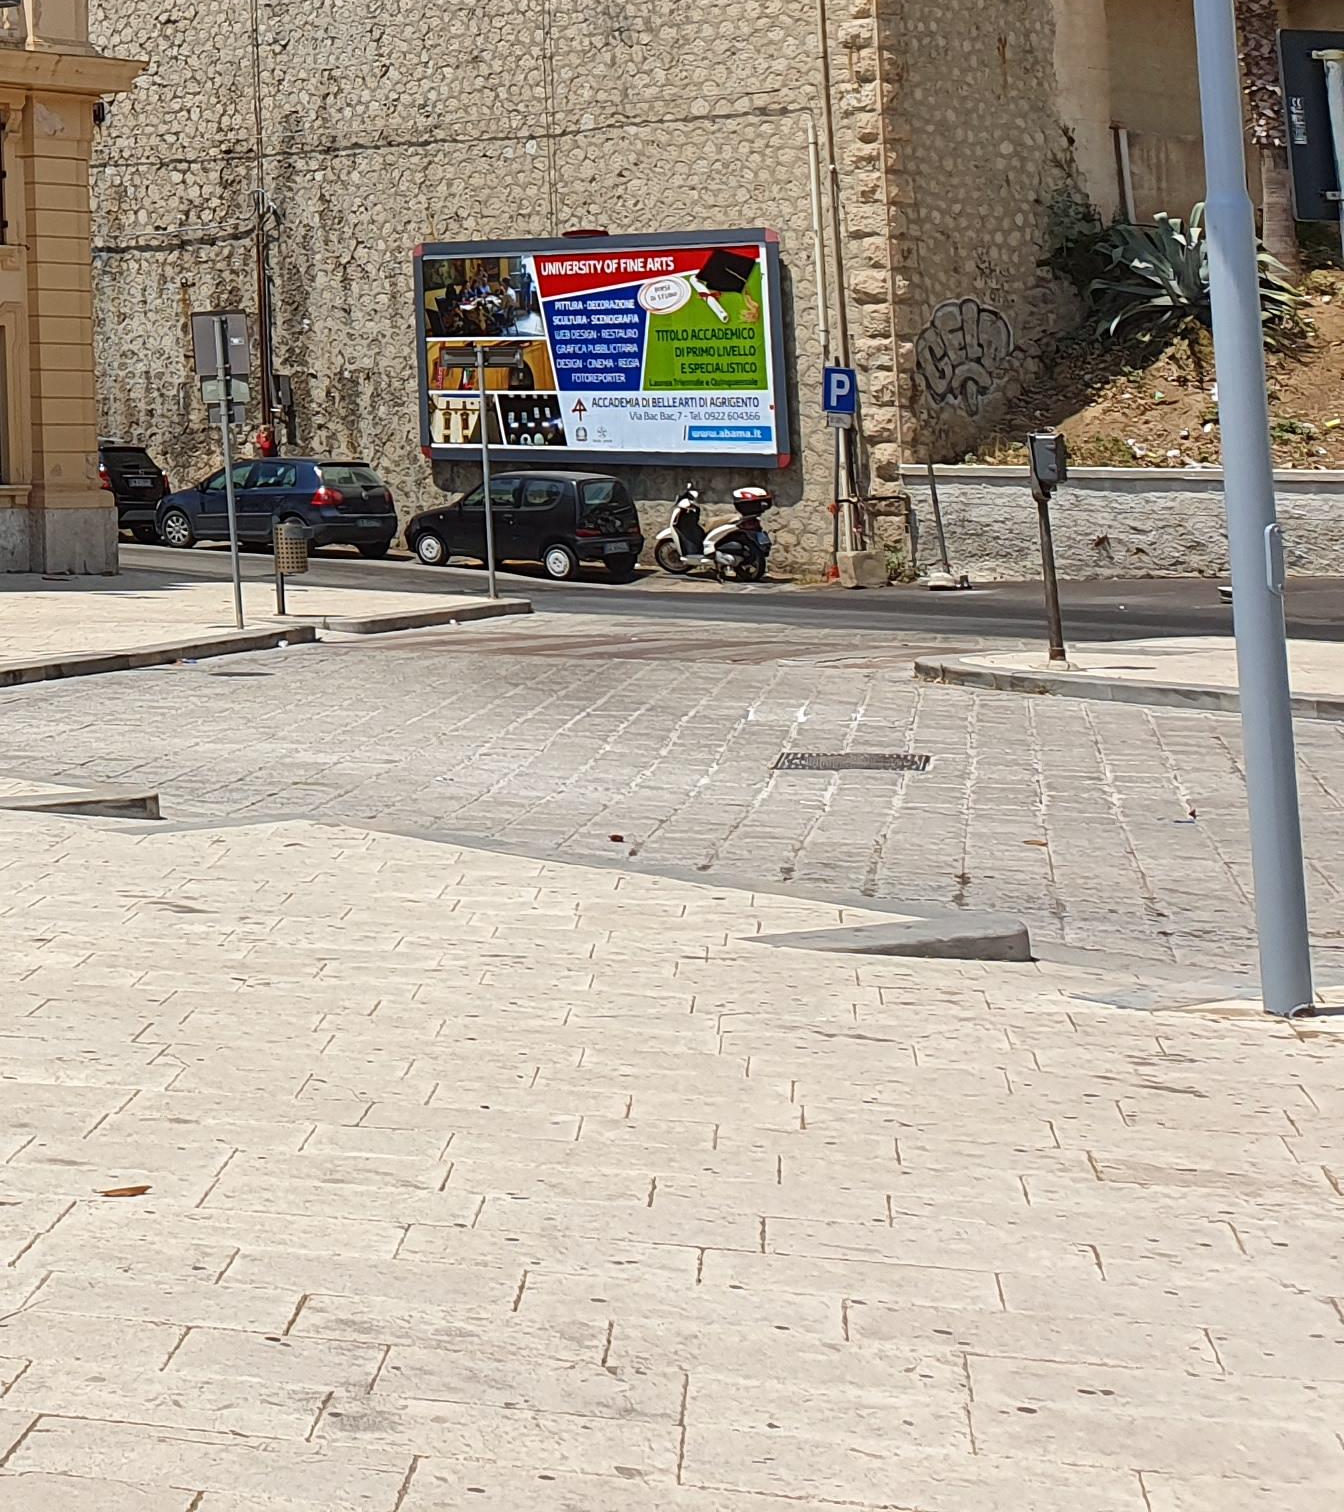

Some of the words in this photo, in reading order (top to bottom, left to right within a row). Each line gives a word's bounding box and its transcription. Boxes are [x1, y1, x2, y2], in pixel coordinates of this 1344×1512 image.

[540, 260, 602, 276] UNIVERSITY
[603, 259, 619, 274] OF
[620, 258, 645, 273] FINE
[646, 256, 675, 271] ARTS
[554, 300, 584, 310] PITTURA
[586, 299, 636, 310] DECORAZIONE
[552, 315, 587, 326] SCULTURA
[590, 314, 640, 324] SCENOGRAFIA
[571, 329, 597, 339] DESIGN
[601, 329, 639, 339] RESTAURO
[655, 329, 689, 341] TITOLO
[690, 328, 756, 340] ACCADEMICO
[556, 344, 588, 354] GRAFICA
[588, 343, 639, 354] PUBBLICITARIA
[675, 346, 684, 357] DI
[686, 346, 716, 357] PRIMO
[717, 345, 757, 357] LIVELLO
[556, 358, 583, 368] DESIGN
[586, 358, 614, 368] CINEMA
[617, 358, 640, 368] REGIA
[680, 363, 687, 374] E
[688, 361, 758, 374] SPECIALISTICO
[571, 373, 626, 383] FOTOREPORTER
[830, 373, 850, 407] P
[592, 397, 641, 408] ACCADEMIA
[641, 397, 651, 408] DI
[651, 397, 678, 408] BELLE
[678, 397, 698, 408] ARTI
[698, 397, 708, 408] DI
[709, 396, 760, 408] AGRIGENTO
[629, 411, 643, 421] Via
[643, 411, 658, 421] Bac
[703, 411, 726, 421] 0922
[691, 428, 762, 439] www.abama.it
